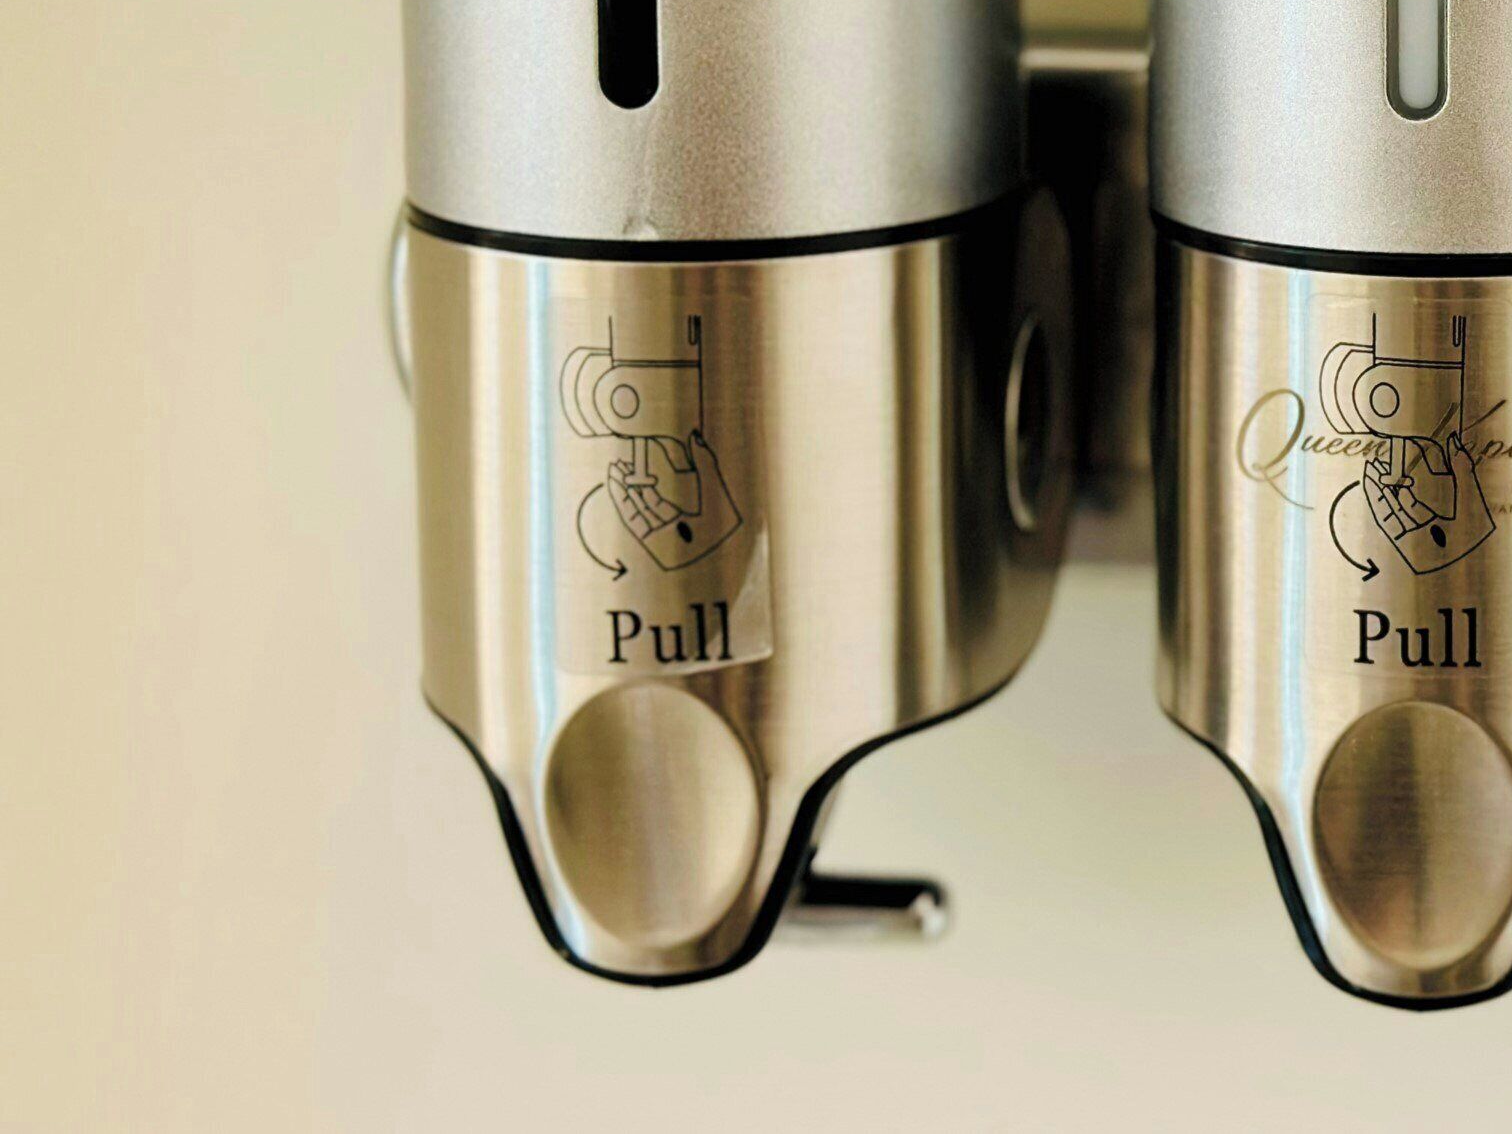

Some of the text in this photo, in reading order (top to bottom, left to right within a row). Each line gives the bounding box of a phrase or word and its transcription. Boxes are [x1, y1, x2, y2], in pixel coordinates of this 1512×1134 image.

[1237, 388, 1388, 510] Queen
[605, 600, 733, 664] Pull
[1353, 607, 1483, 668] Pull
